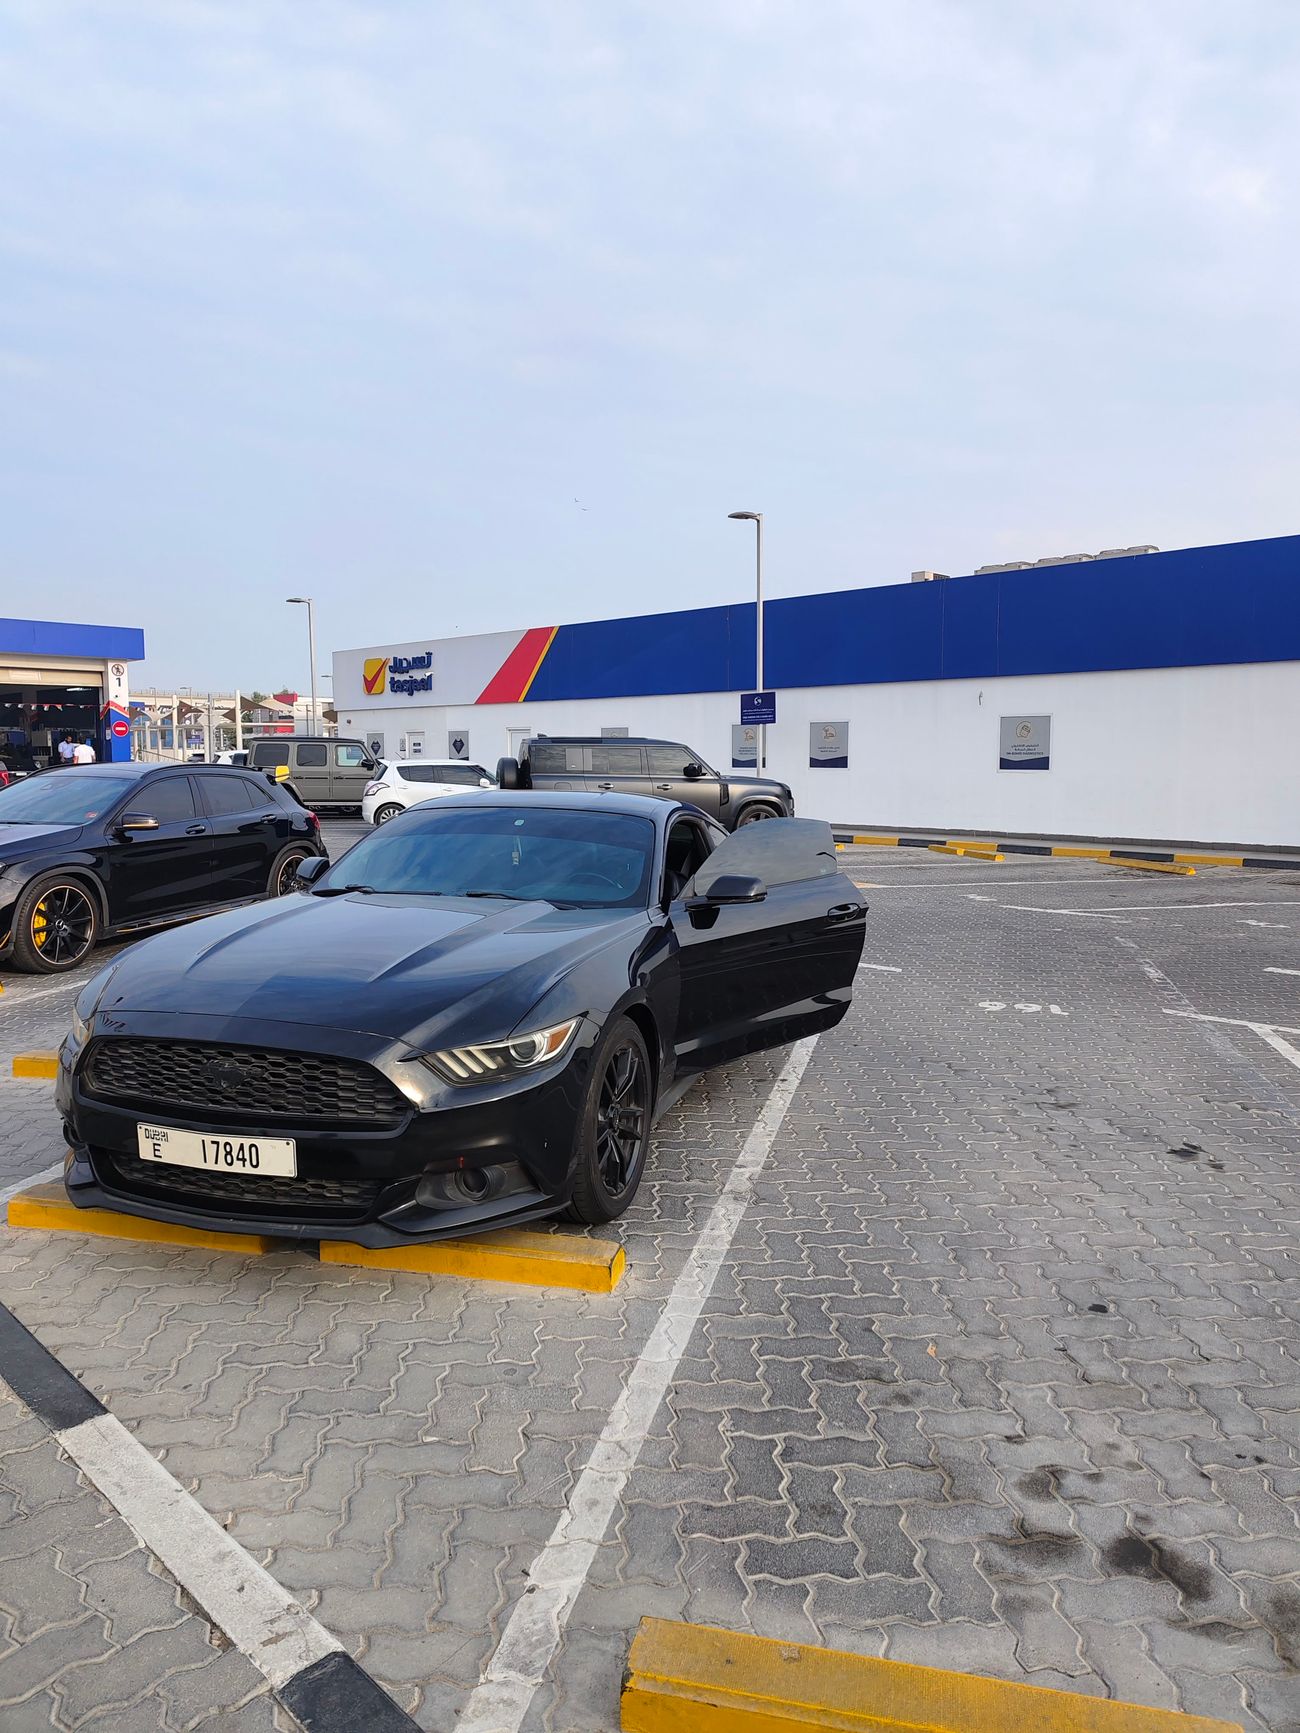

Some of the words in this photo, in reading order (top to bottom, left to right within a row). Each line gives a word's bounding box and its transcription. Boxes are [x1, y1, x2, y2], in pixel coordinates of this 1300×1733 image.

[389, 652, 433, 674] تسجيل
[116, 677, 121, 687] 1
[389, 674, 433, 696] tasjeel
[153, 1143, 163, 1158] E
[202, 1139, 260, 1169] 17840
